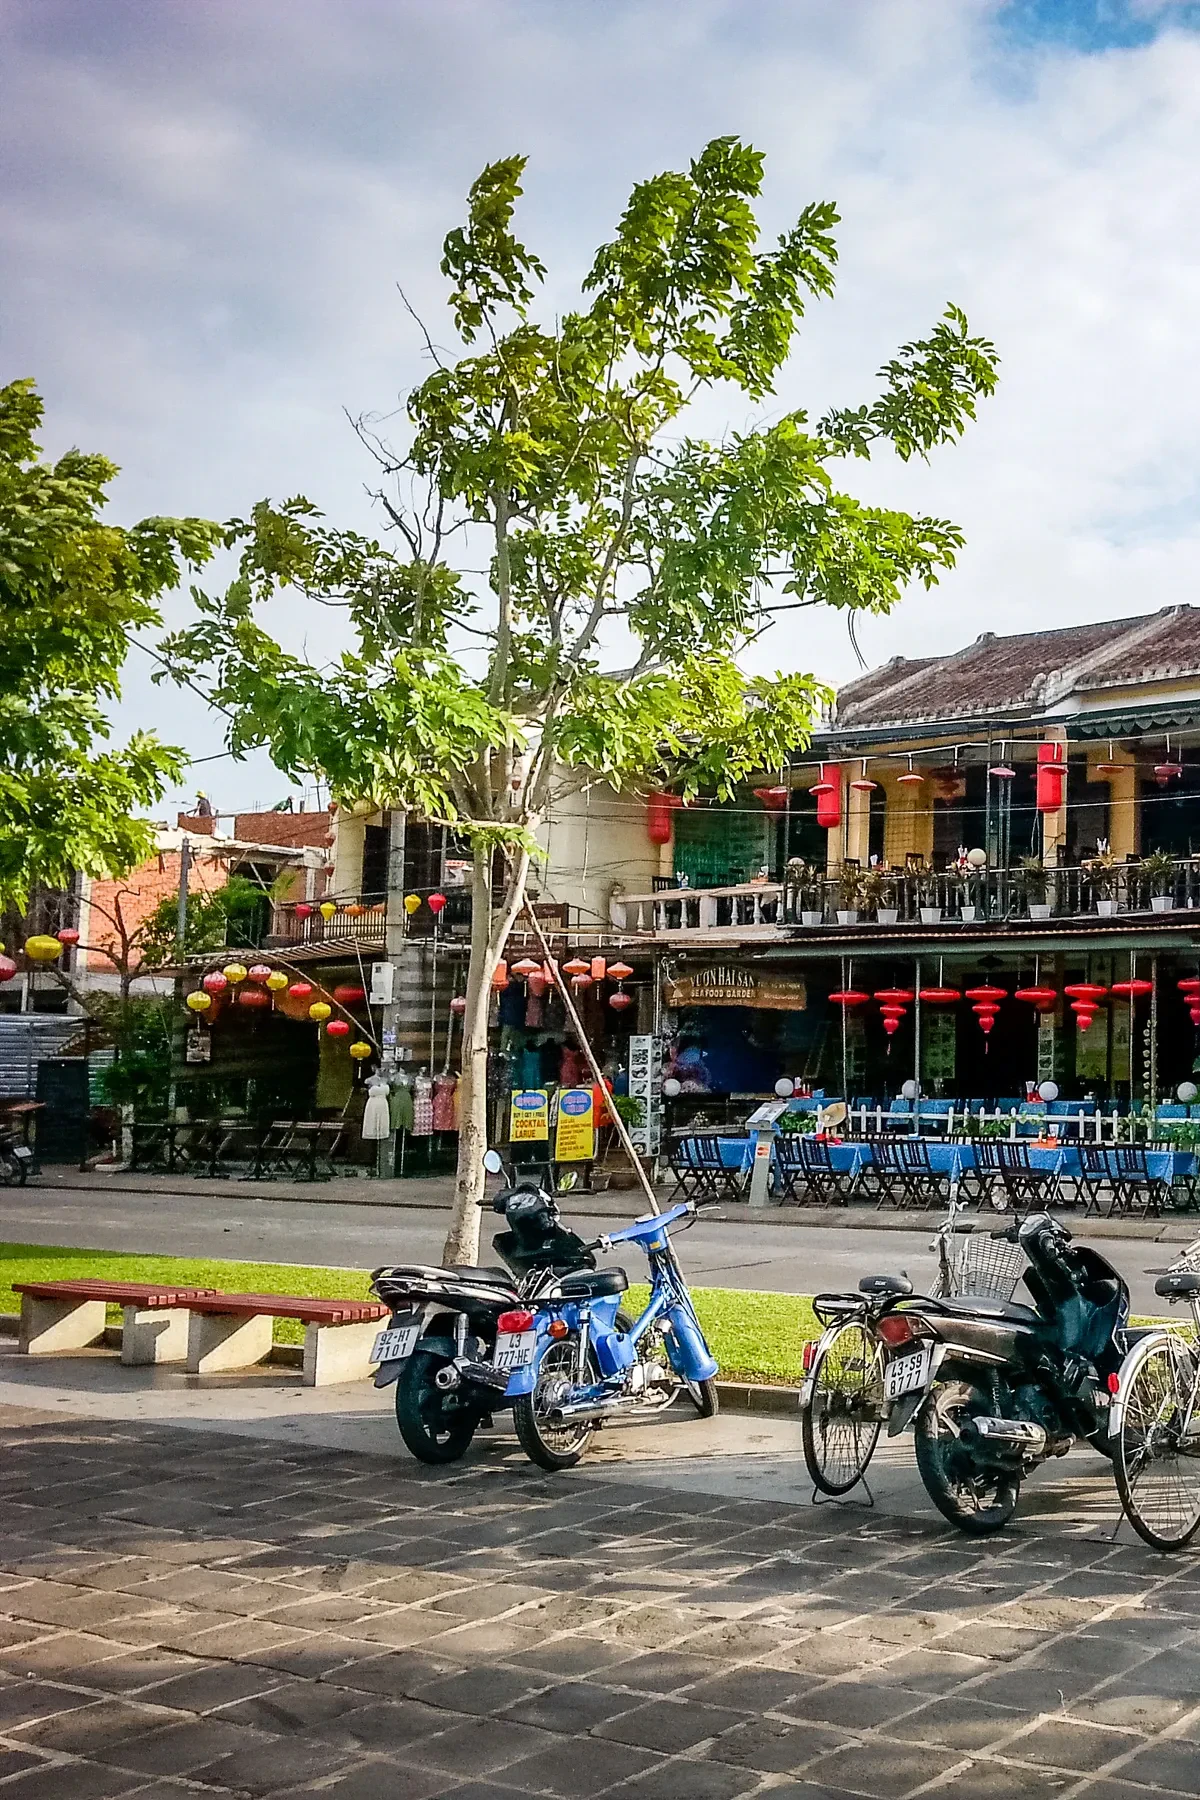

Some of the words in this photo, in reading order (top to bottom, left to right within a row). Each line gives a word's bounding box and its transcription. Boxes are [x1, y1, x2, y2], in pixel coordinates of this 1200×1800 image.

[691, 989, 724, 998] SEAFOOD
[726, 989, 756, 998] GARDEN
[515, 1119, 546, 1128] COCKTAIL
[515, 1129, 536, 1138] LARUE
[380, 1329, 411, 1346] 92-H1
[509, 1333, 522, 1348] 43
[376, 1343, 407, 1360] 7101
[498, 1348, 530, 1366] 777-HE
[891, 1354, 923, 1378] 43-S9
[890, 1370, 921, 1396] 8777
